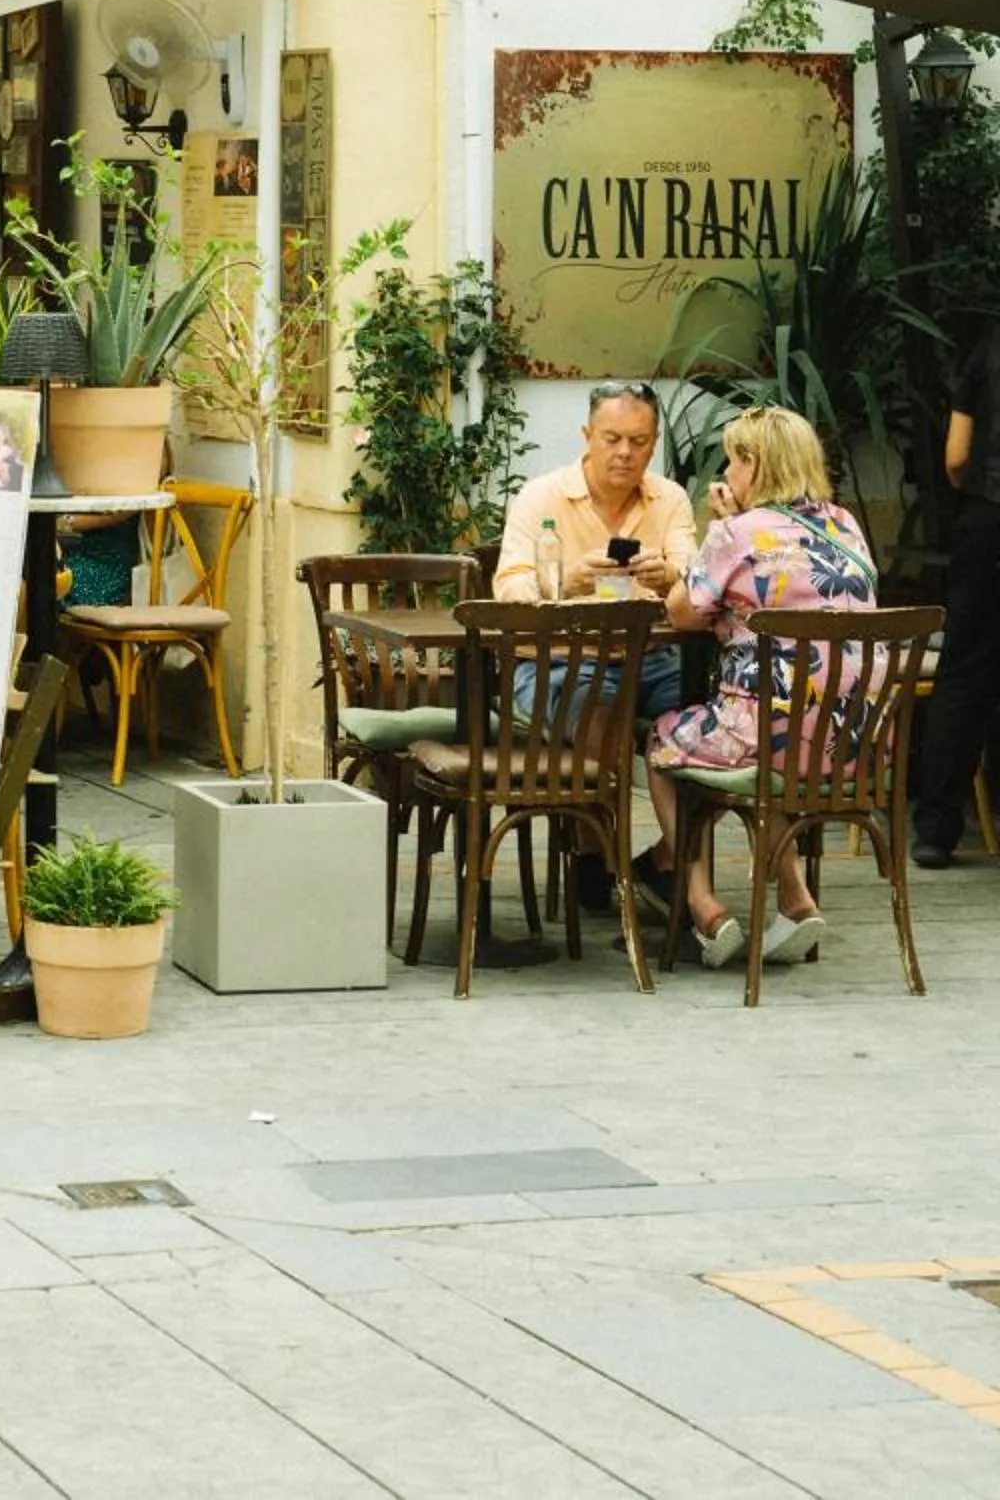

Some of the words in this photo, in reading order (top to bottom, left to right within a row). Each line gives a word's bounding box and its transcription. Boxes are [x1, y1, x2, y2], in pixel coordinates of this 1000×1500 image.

[310, 70, 325, 151] TAPAS
[643, 161, 681, 173] DESDE
[542, 177, 648, 259] CA'N
